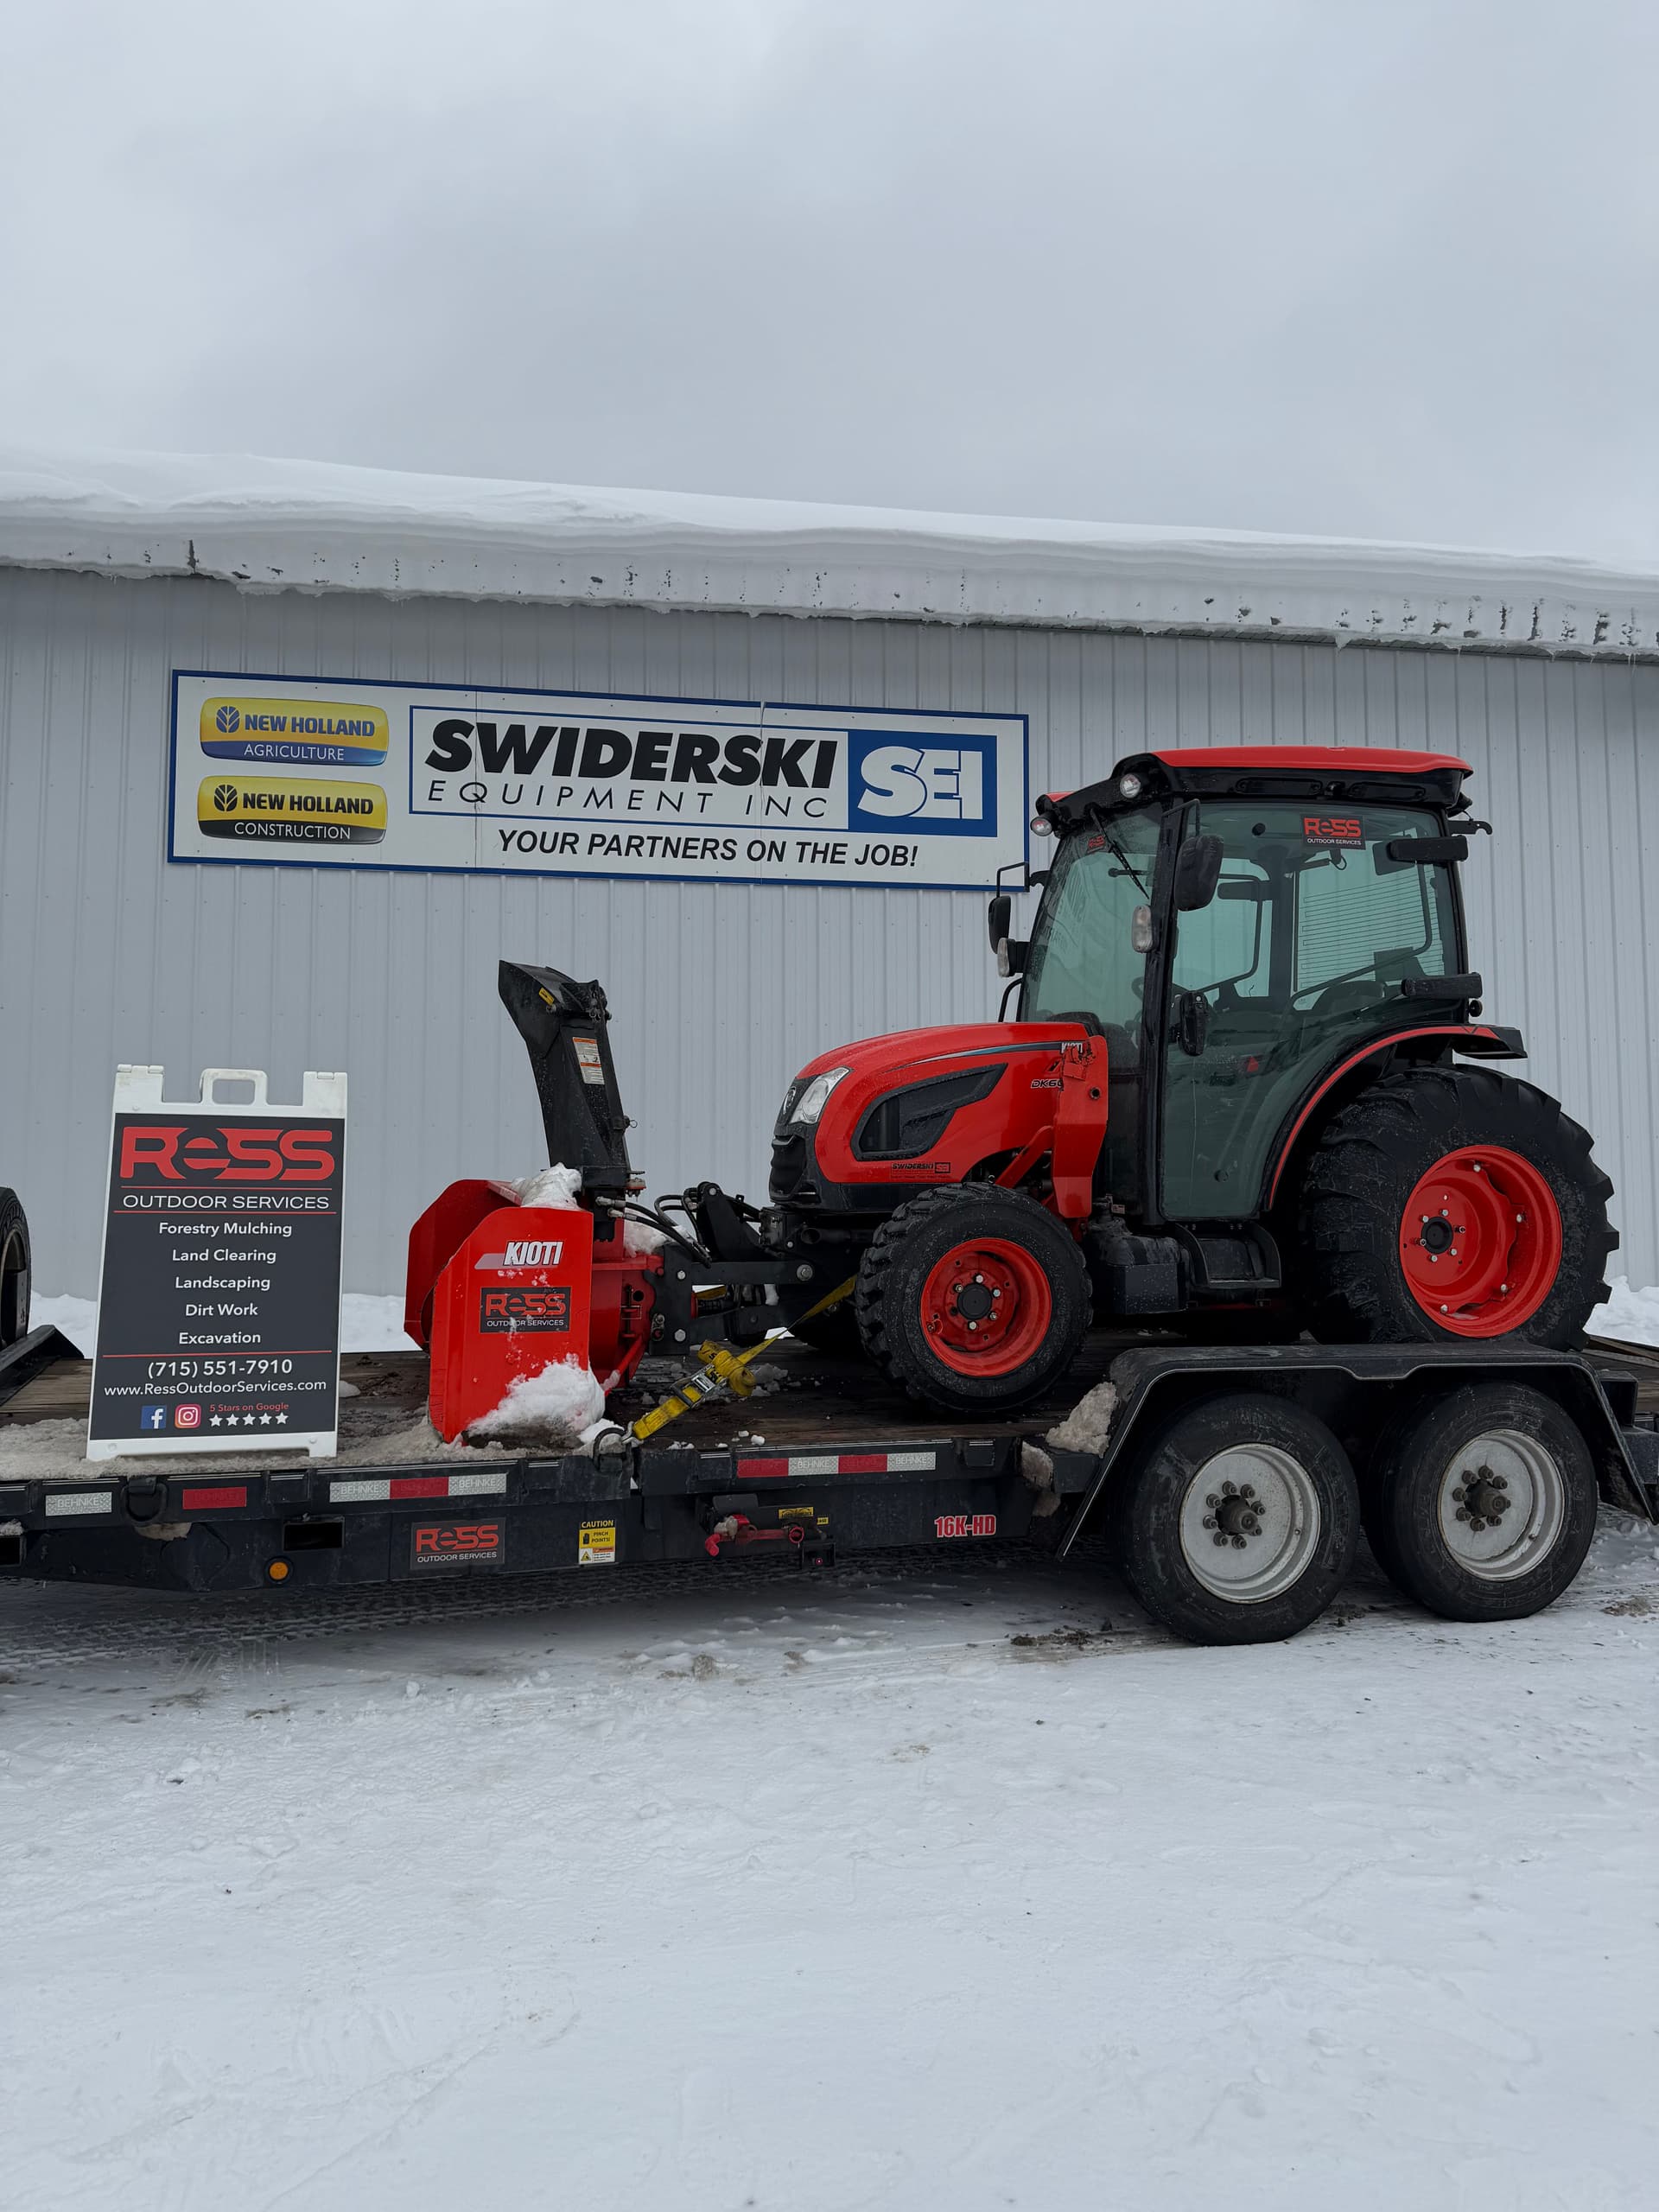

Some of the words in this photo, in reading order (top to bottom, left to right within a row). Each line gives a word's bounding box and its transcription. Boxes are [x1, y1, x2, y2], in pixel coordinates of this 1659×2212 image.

[245, 714, 286, 733] NEW
[291, 716, 375, 737] HOLLAND
[244, 744, 345, 760] AGRICULTURE
[424, 719, 838, 789] SWIDERSKI
[856, 746, 982, 820] SEI
[243, 793, 285, 810] NEW
[289, 795, 373, 816] HOLLAND
[429, 780, 713, 813] EQUIPMENT
[746, 796, 828, 817] INC
[234, 822, 351, 840] CONSTRUCTION
[498, 830, 578, 855] YOUR
[587, 834, 738, 861] PARTNERS
[747, 840, 786, 861] ON
[796, 842, 849, 864] THE
[855, 843, 918, 867] JOB!
[123, 1195, 226, 1208] OUTDOOR
[232, 1196, 329, 1209] SERVICES
[159, 1223, 219, 1236] Forestry
[224, 1223, 292, 1236] Mulching
[173, 1249, 209, 1262] Land
[214, 1249, 276, 1263] Clearing
[504, 1241, 563, 1266] KIOTI
[175, 1276, 270, 1291] Landscaping
[186, 1304, 213, 1316] Dirt
[218, 1303, 257, 1316] Work
[179, 1332, 261, 1344] Excavation
[148, 1361, 198, 1378] (715)
[203, 1359, 292, 1376] 551-7910
[104, 1380, 327, 1395] www.RessOutdoorServices.com
[256, 1402, 289, 1411] Google
[798, 1459, 830, 1469] BEHNKE
[896, 1455, 928, 1465] BEHNKE
[340, 1484, 380, 1496] BEHNKE
[460, 1478, 497, 1488] BEHNKE
[57, 1495, 100, 1508] BEHNKE
[582, 1520, 613, 1529] CAUTION
[934, 1515, 996, 1537] 16K-HD
[417, 1554, 457, 1563] OUTDOOR
[459, 1551, 497, 1560] SERVICES
